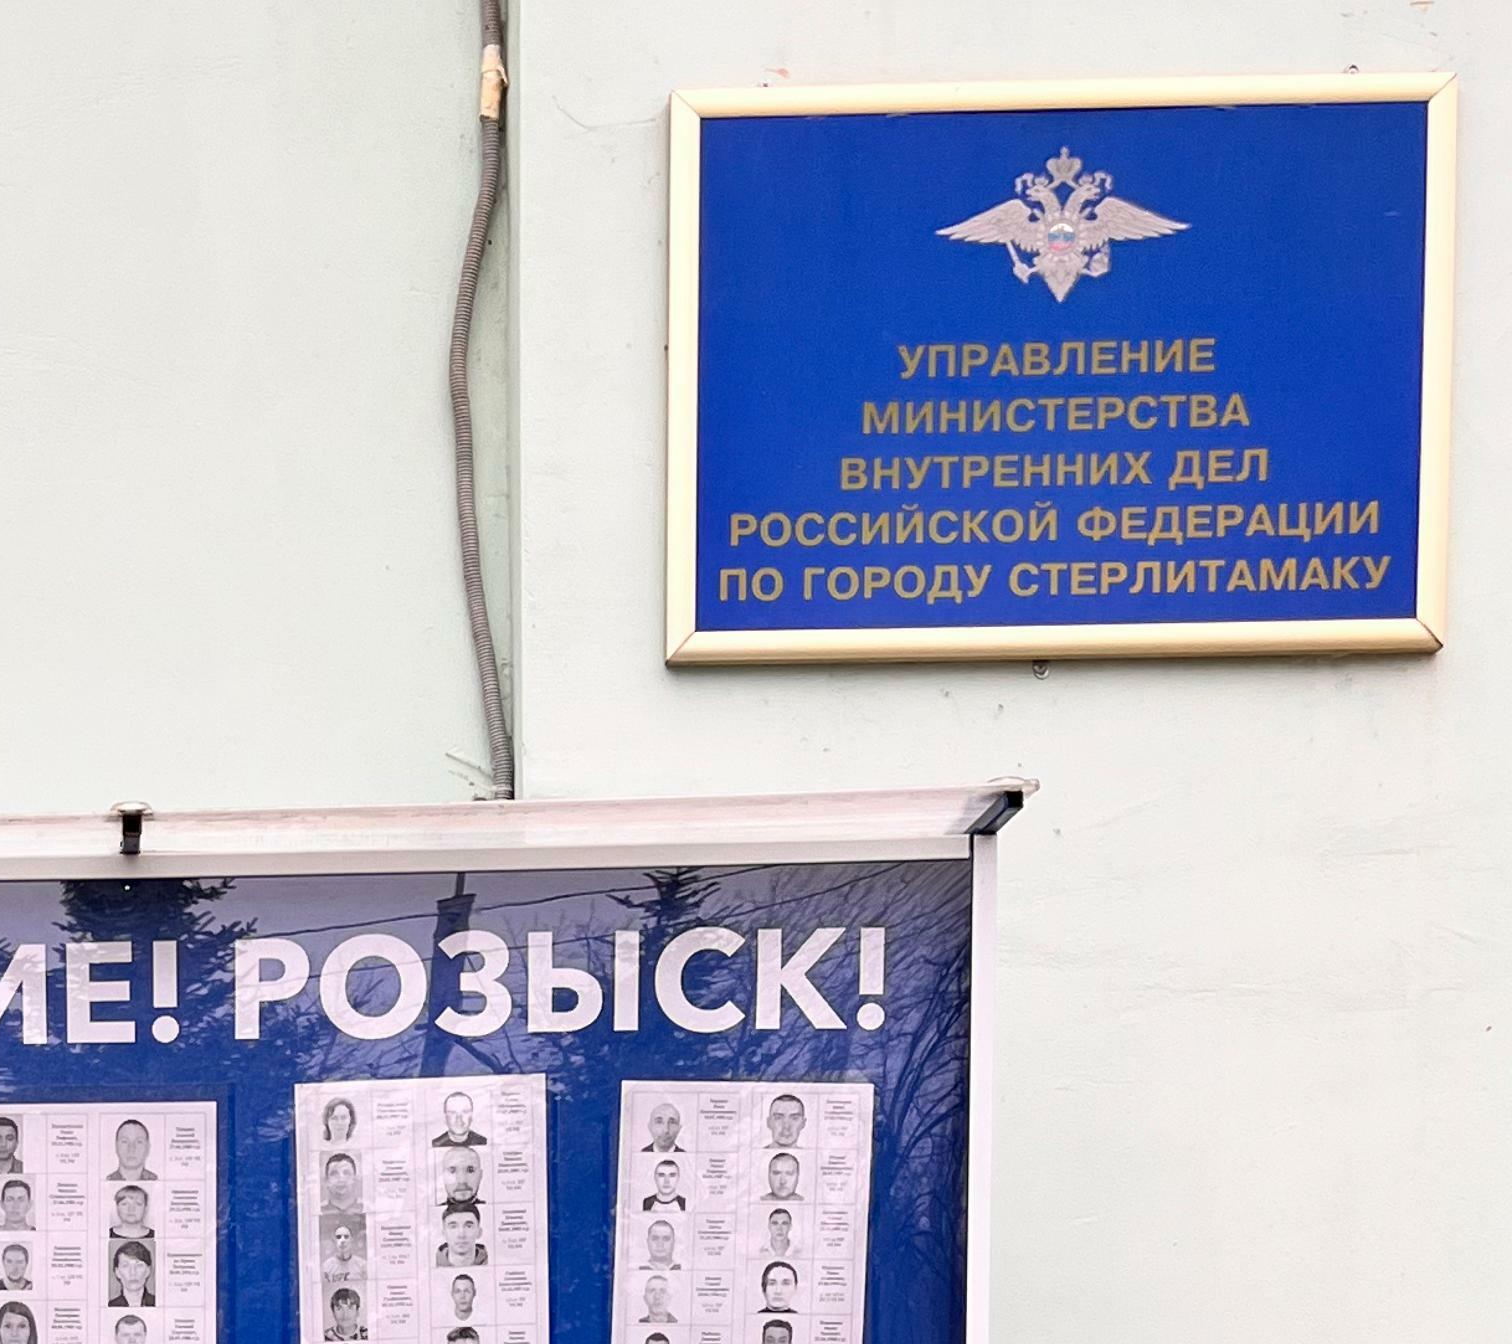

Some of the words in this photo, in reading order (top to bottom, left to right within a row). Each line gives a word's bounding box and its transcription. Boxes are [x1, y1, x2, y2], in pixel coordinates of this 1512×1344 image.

[898, 337, 1216, 380] УПРАВЛЕНИЕ
[862, 393, 1251, 436] МИНИСТЕРСТВА
[839, 451, 1152, 491] ВНУТРЕННИХ
[1168, 447, 1270, 490] ДЕЛ
[729, 501, 1058, 547] РОССИЙСКОЙ
[1077, 500, 1380, 547] ФЕДЕРАЦИИ
[719, 566, 785, 602] ПО
[803, 563, 992, 605] ГОРОДУ
[1008, 554, 1392, 597] СТЕРЛИТАМАКУ
[233, 926, 886, 1041] РОЗЫСК!
